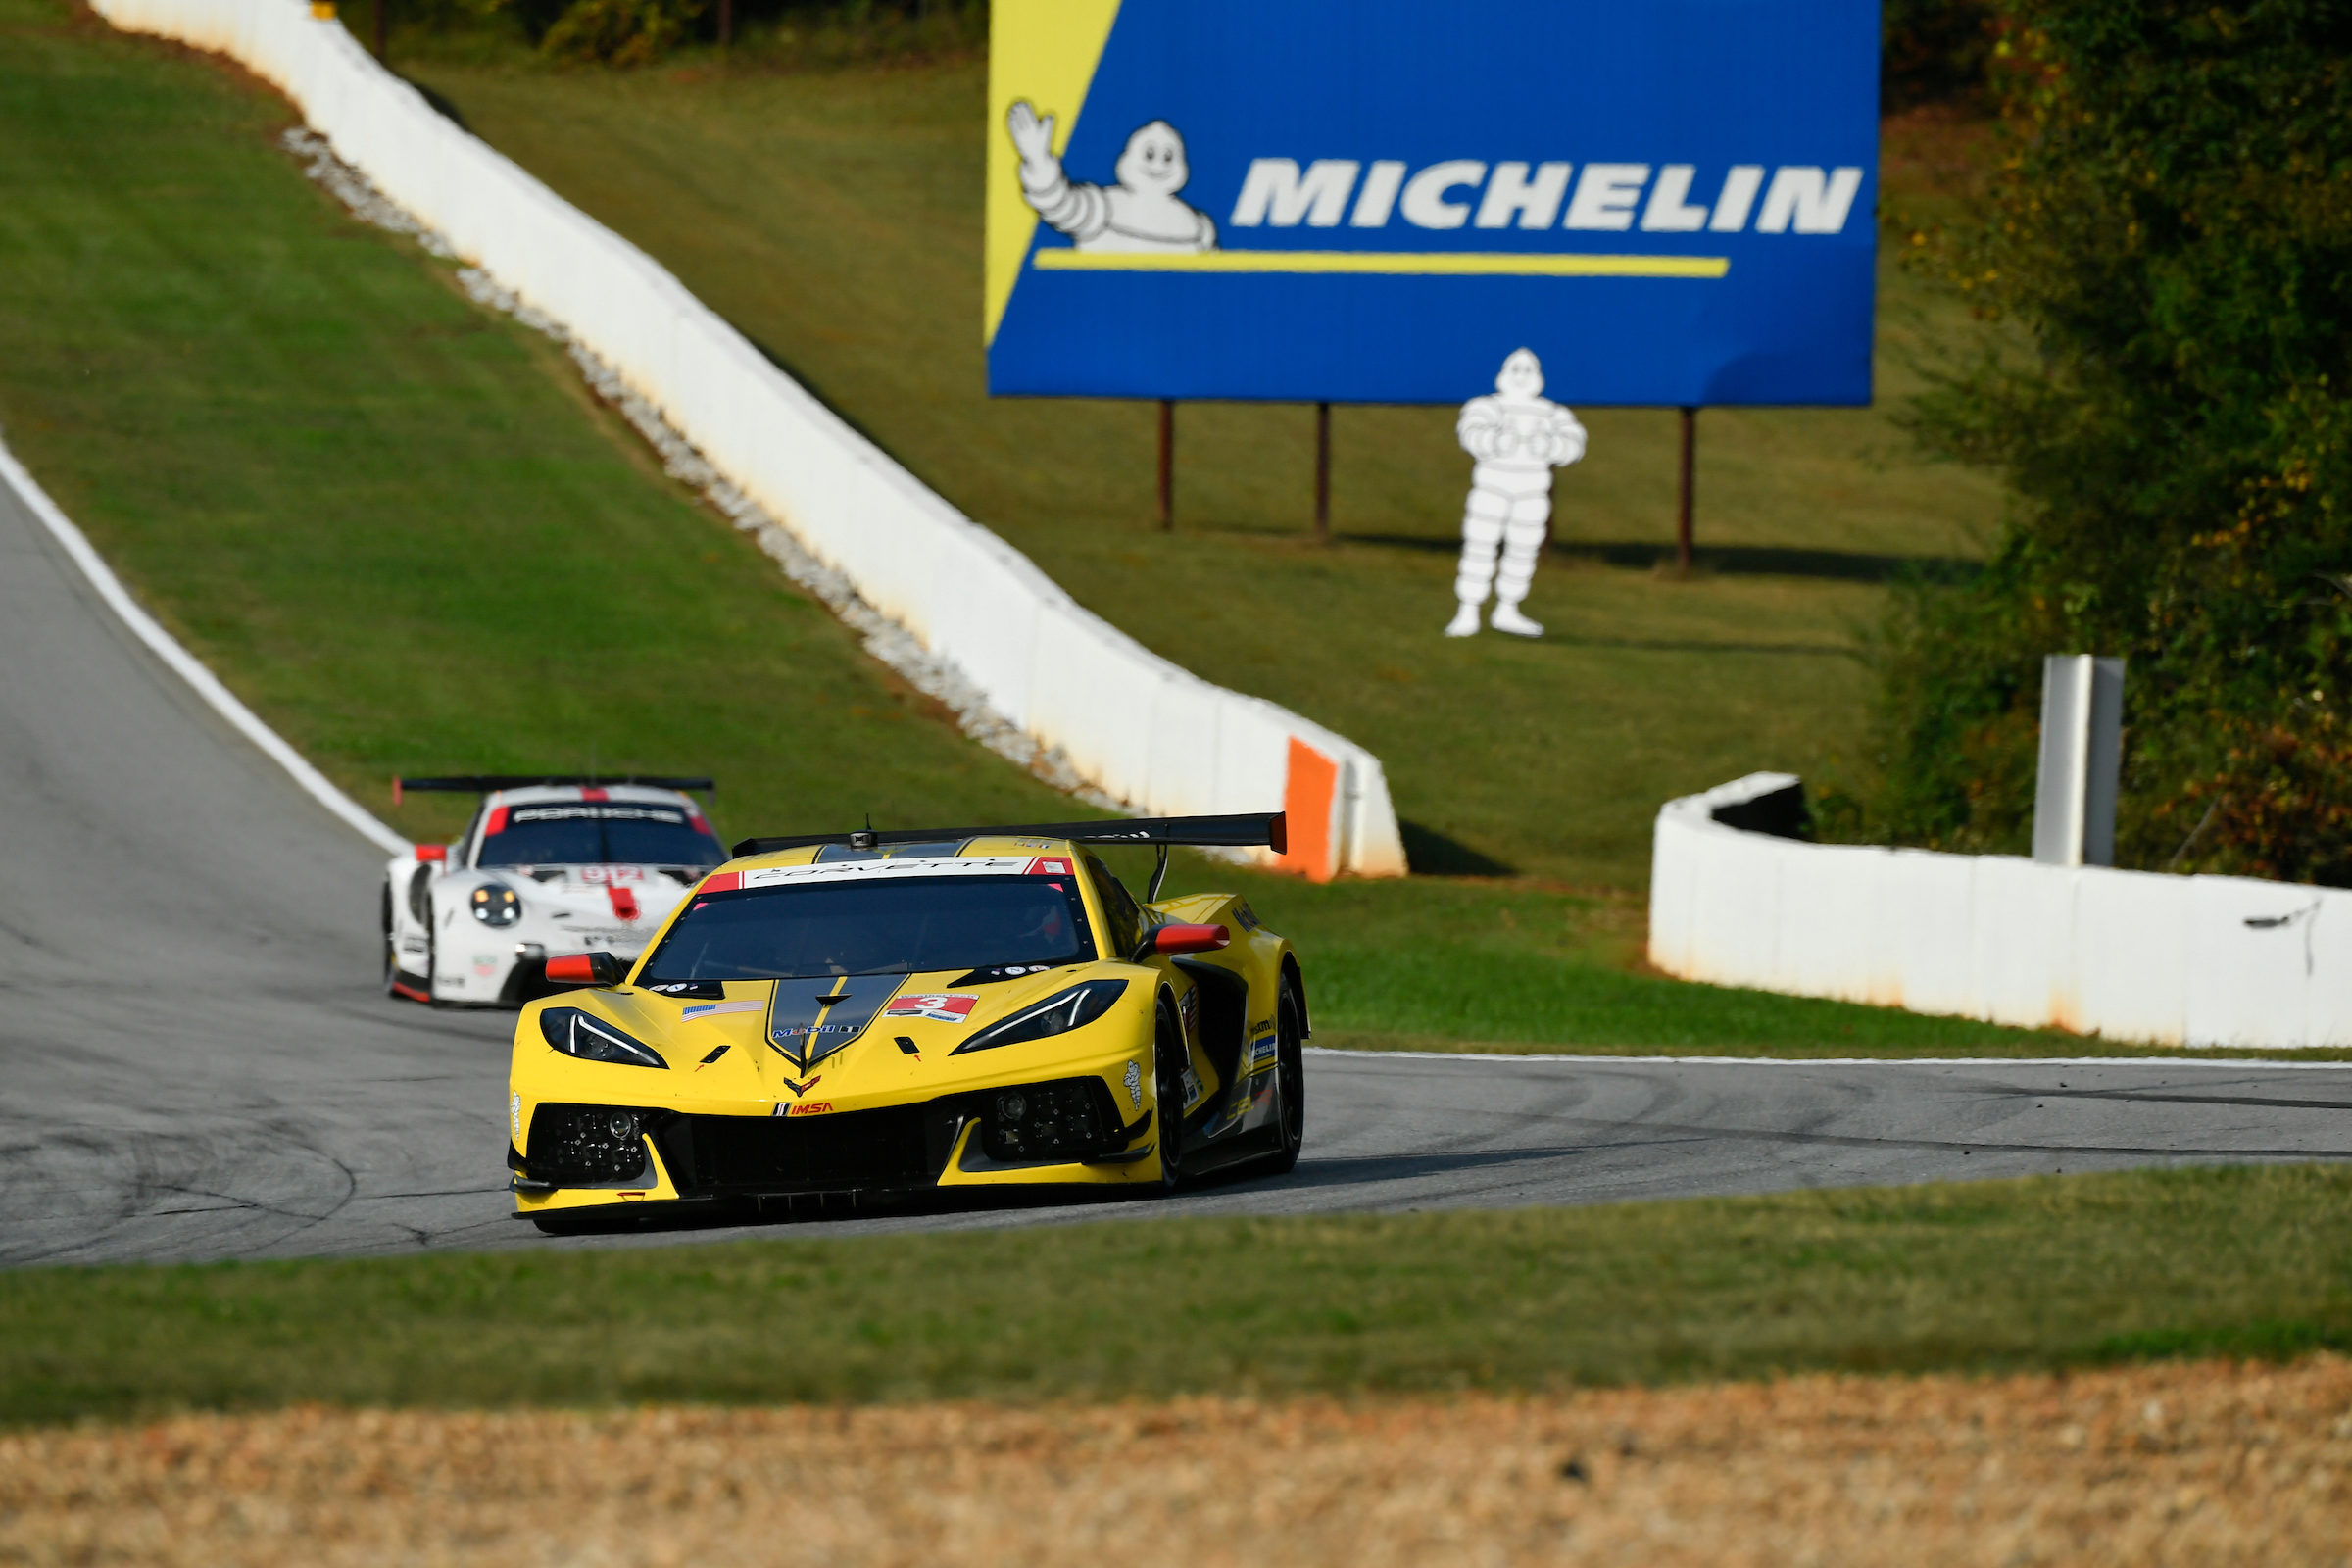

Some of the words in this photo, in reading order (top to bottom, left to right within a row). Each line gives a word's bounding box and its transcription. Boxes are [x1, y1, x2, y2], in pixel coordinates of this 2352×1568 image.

[1231, 158, 1863, 234] MICHELIN
[582, 866, 644, 884] 912
[753, 860, 1019, 880] CORVETTE
[914, 997, 948, 1010] 3
[772, 1024, 836, 1039] Mobil
[791, 1102, 834, 1116] IMSA
